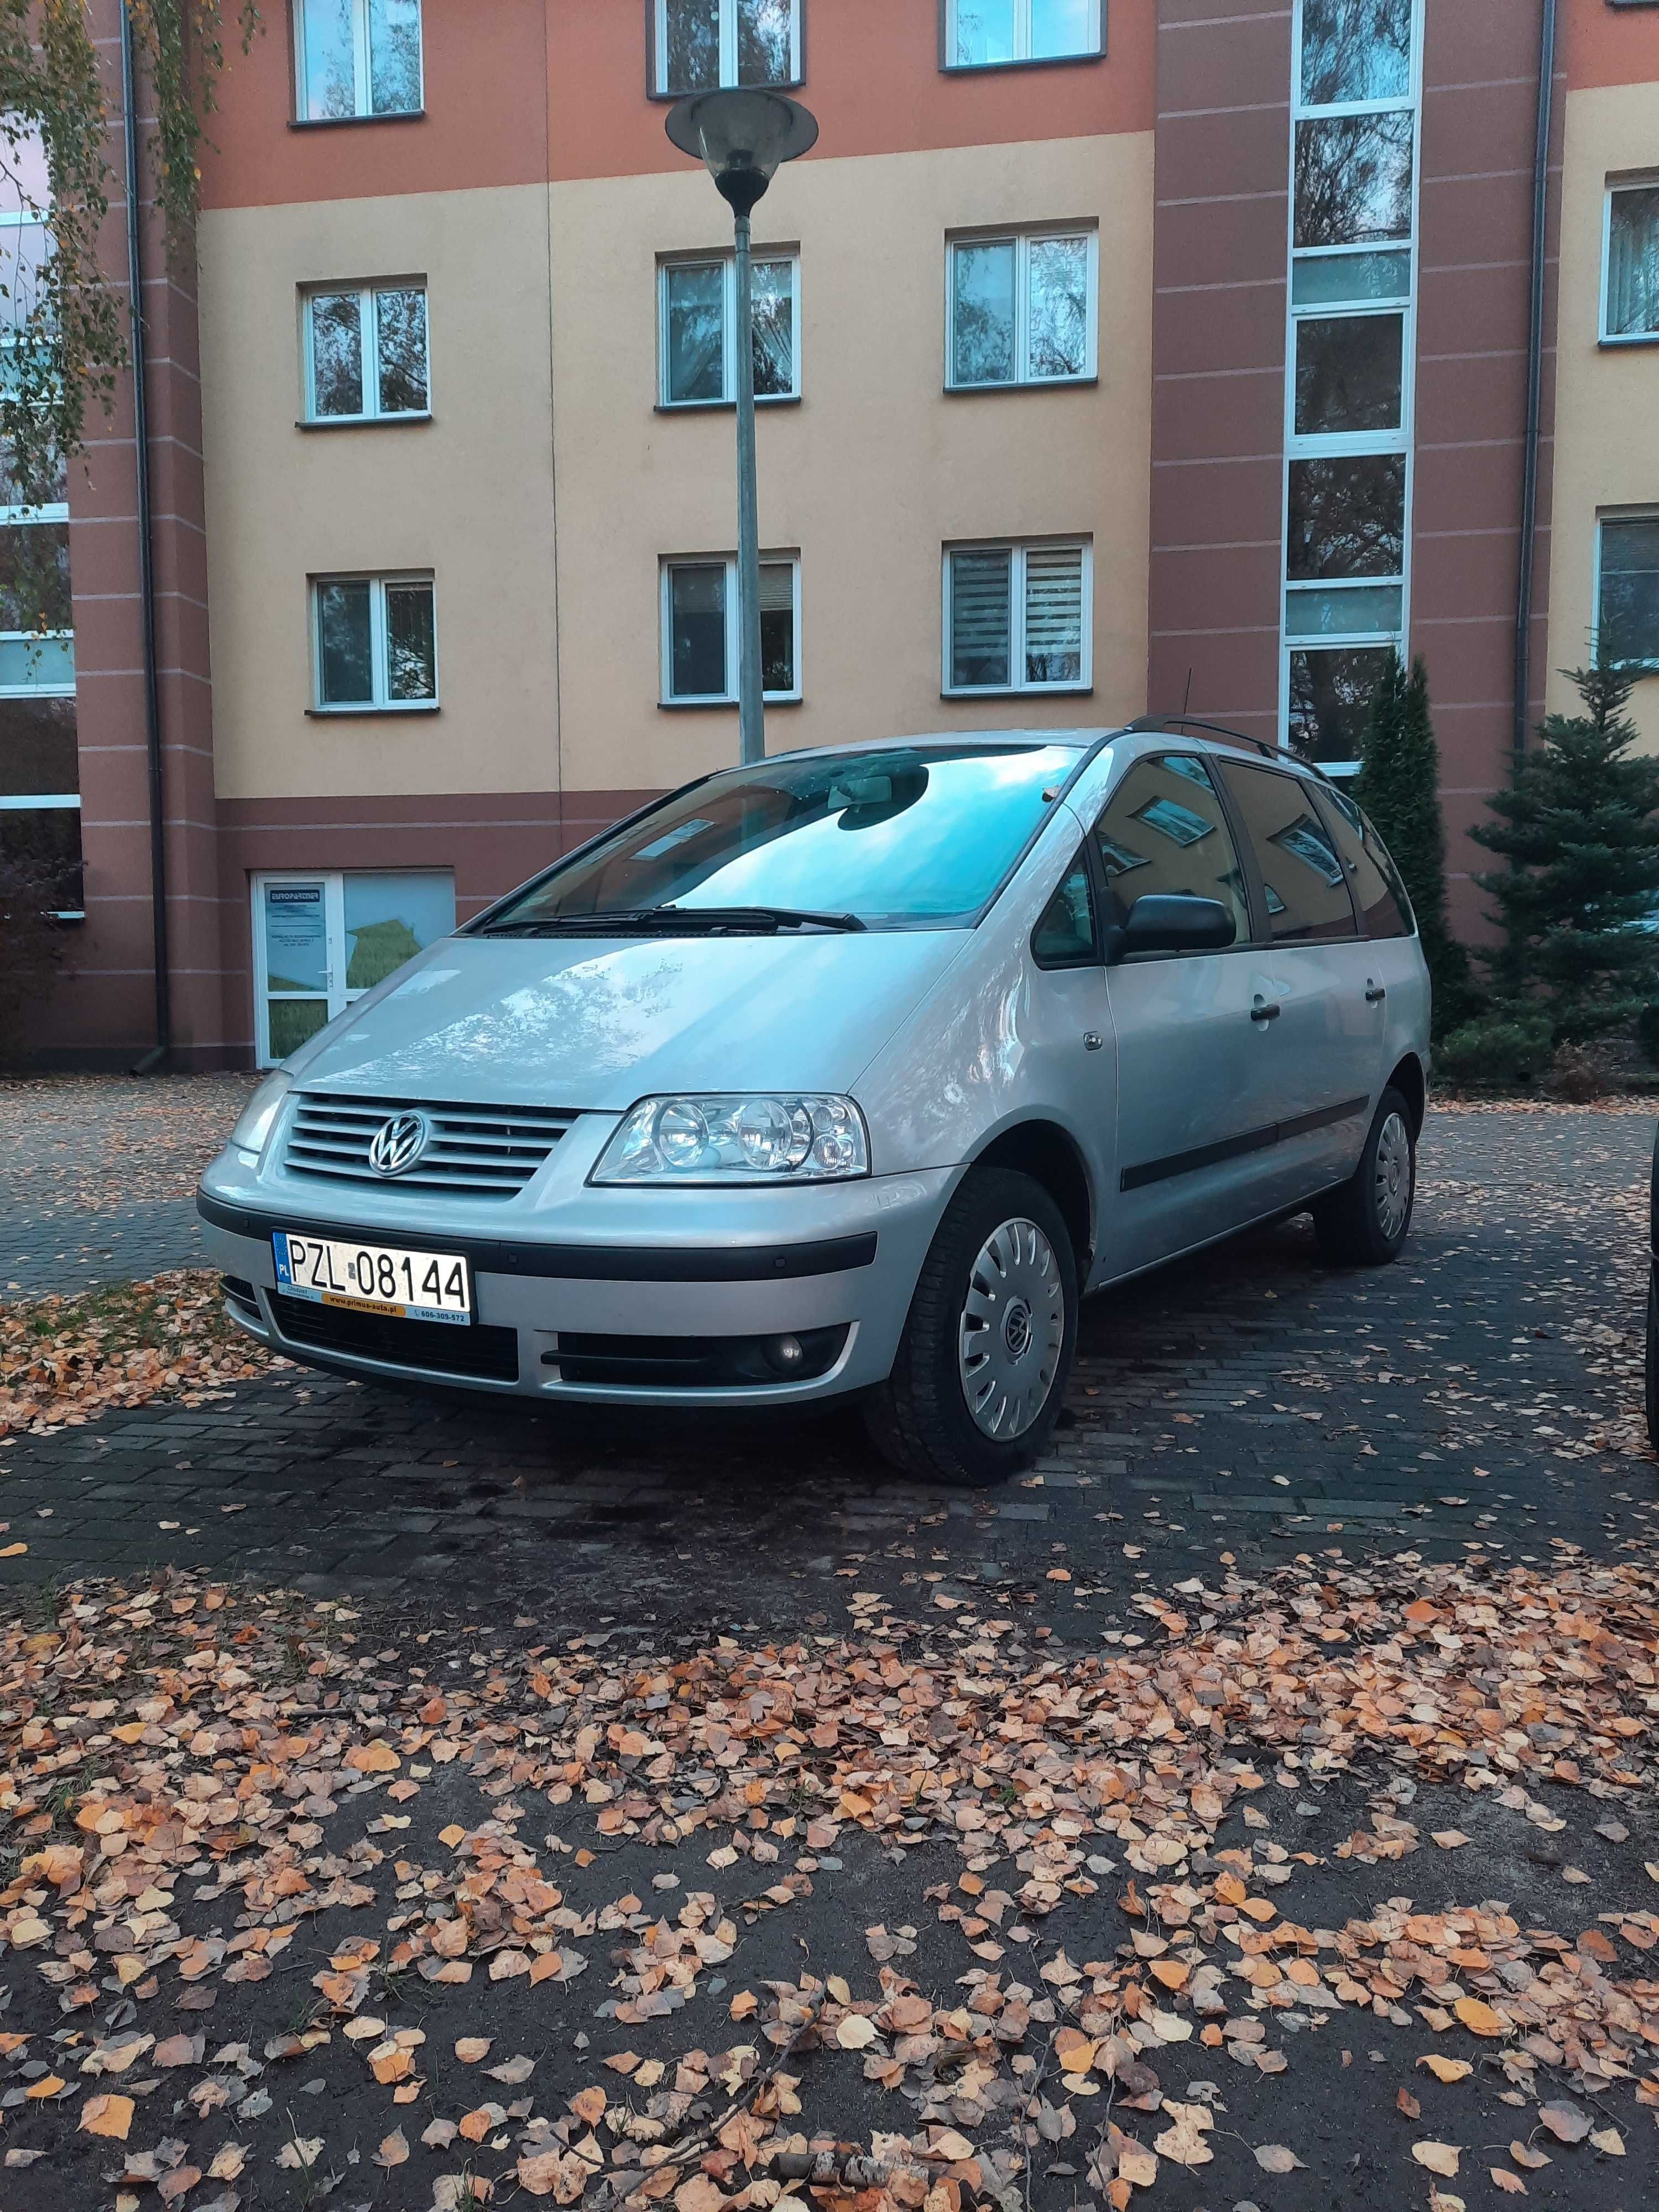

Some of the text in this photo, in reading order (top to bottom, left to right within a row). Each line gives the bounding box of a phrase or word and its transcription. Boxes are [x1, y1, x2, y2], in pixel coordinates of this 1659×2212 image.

[279, 1264, 289, 1276] PL
[289, 1239, 465, 1308] PZL 08144
[330, 1297, 397, 1314] www.primus-auta.pl
